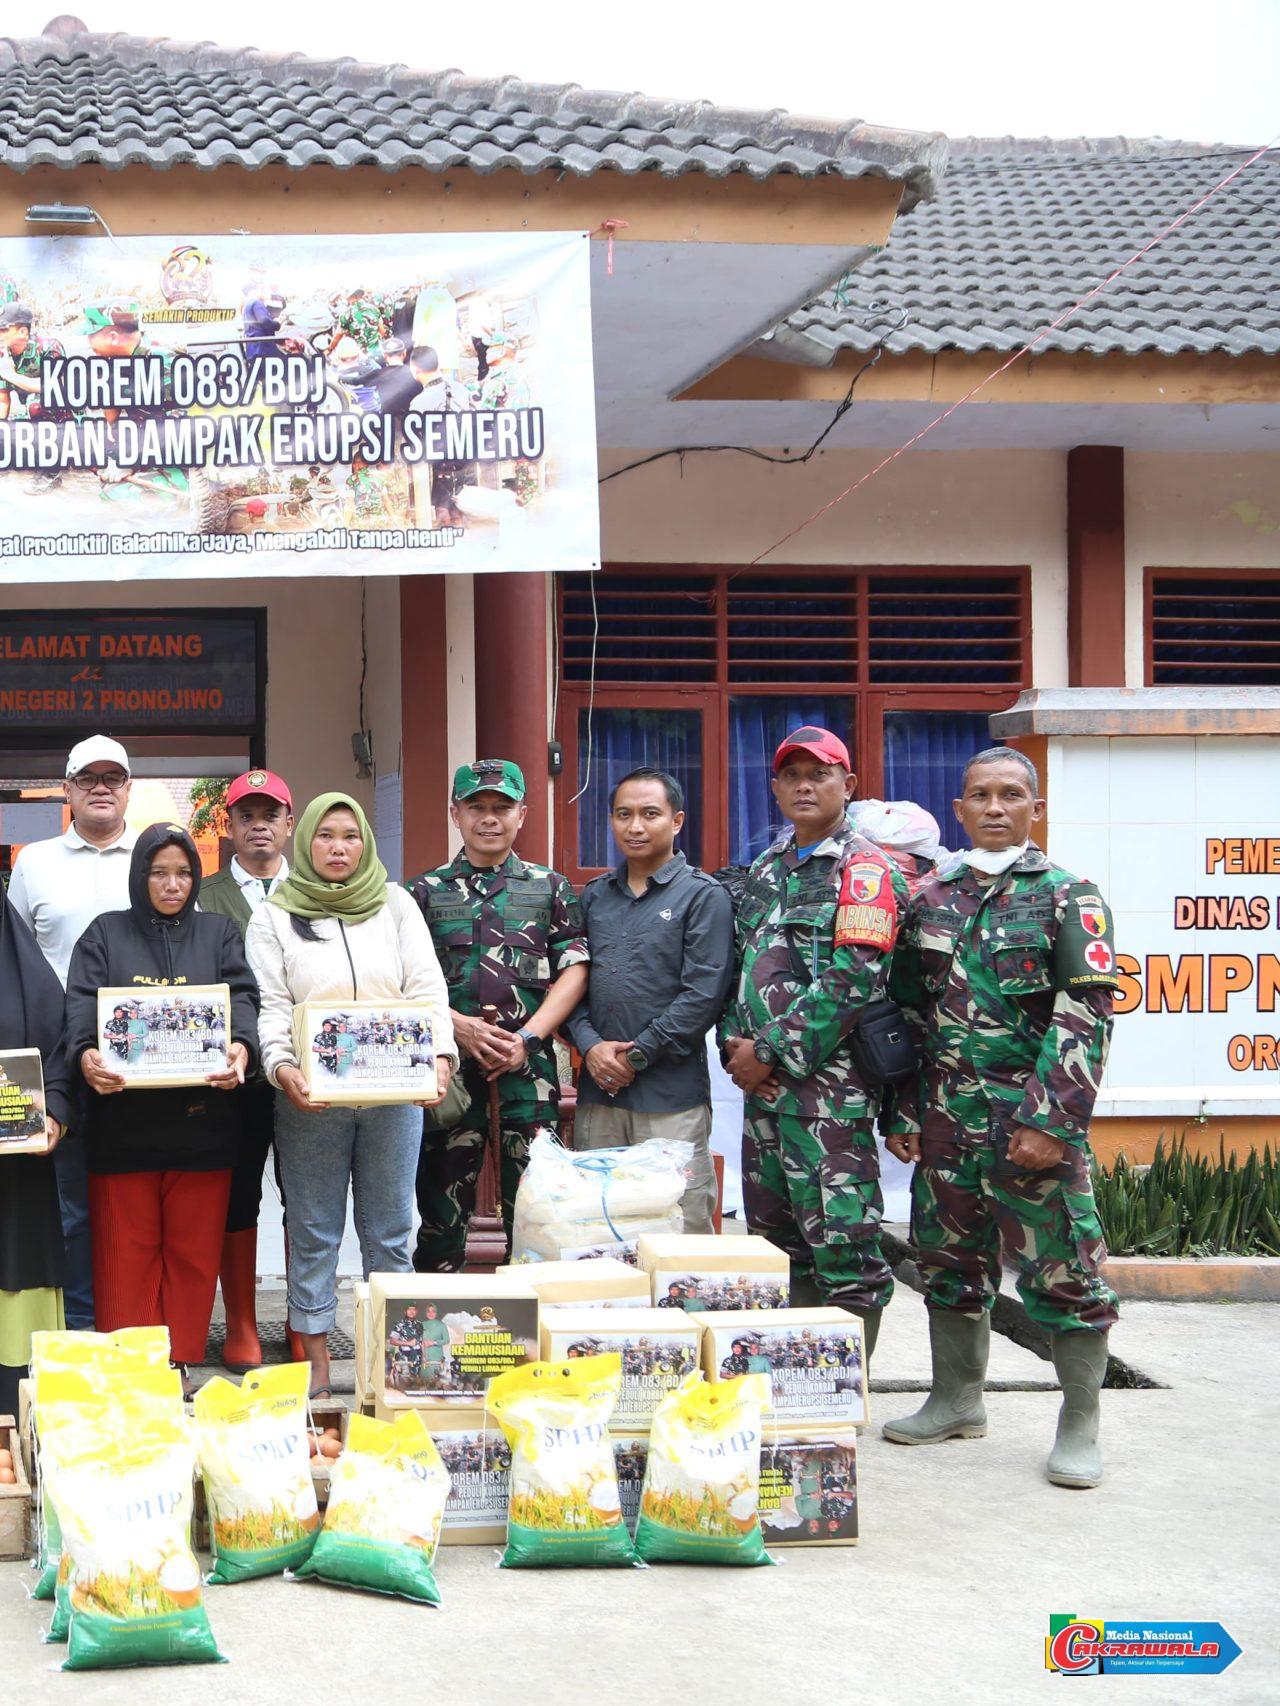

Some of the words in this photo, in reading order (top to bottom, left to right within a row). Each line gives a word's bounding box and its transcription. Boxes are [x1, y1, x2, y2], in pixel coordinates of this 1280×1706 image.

[142, 310, 185, 323] SEMAKIN
[185, 309, 236, 323] PRODUKTIF
[42, 354, 162, 410] KOREM
[172, 351, 328, 407] 083/BDJ
[117, 413, 263, 469] DAMPAK
[272, 410, 393, 465] ERUPSI
[401, 407, 545, 462] SEMERU
[23, 533, 109, 556] Produktif
[110, 531, 201, 554] Baladhika
[203, 532, 252, 553] Jaya,
[254, 528, 347, 551] Mengabdi
[348, 528, 405, 550] Tanpa
[407, 526, 464, 548] Henti"
[99, 634, 203, 658] DATANG
[71, 665, 103, 683] di
[0, 689, 76, 711] NEGERI
[81, 690, 95, 711] 2
[100, 688, 223, 711] PRONOJIWO
[1206, 838, 1280, 874] PEME
[999, 912, 1018, 923] TNI
[1027, 909, 1046, 920] AD
[1175, 896, 1270, 930] DINAS
[148, 1031, 176, 1042] KOREM
[358, 1045, 387, 1057] KOREM
[1227, 1034, 1280, 1071] OR
[464, 1332, 512, 1344] BANTUAN
[451, 1344, 526, 1356] KEMANUSIAAN
[772, 1368, 805, 1381] KOREM
[808, 1366, 850, 1380] 083/BDJ
[824, 1392, 852, 1405] SEMERU
